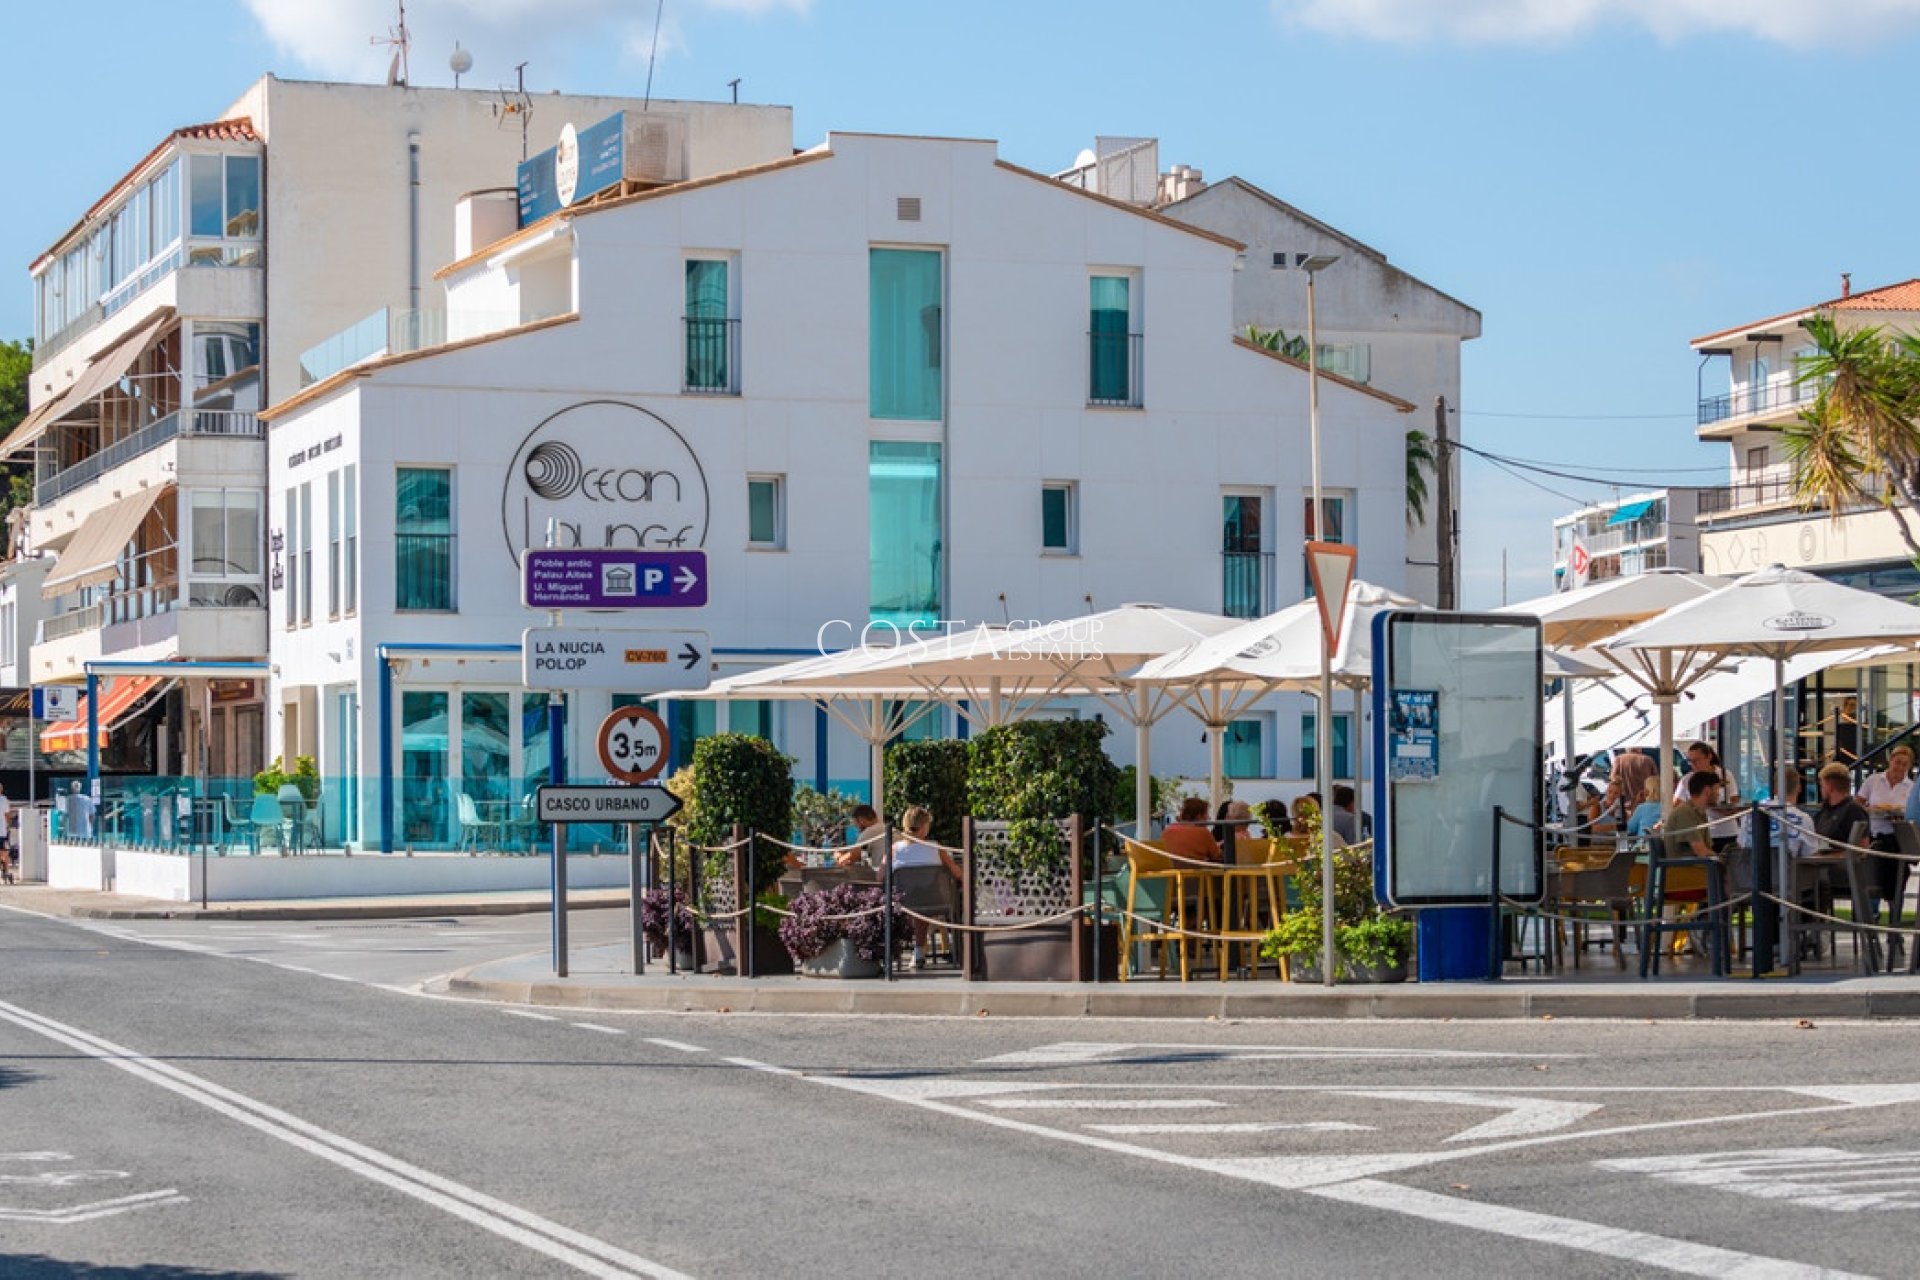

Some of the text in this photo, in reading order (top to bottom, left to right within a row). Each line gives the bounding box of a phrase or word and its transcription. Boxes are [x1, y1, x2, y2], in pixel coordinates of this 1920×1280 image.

[534, 559, 592, 568] Poble antic
[534, 570, 593, 579] Palau Altea
[644, 568, 664, 591] P
[547, 582, 583, 593] Miguel
[535, 641, 555, 654] LA
[535, 658, 587, 670] POLOP
[546, 797, 649, 812] CASCO URBANO
